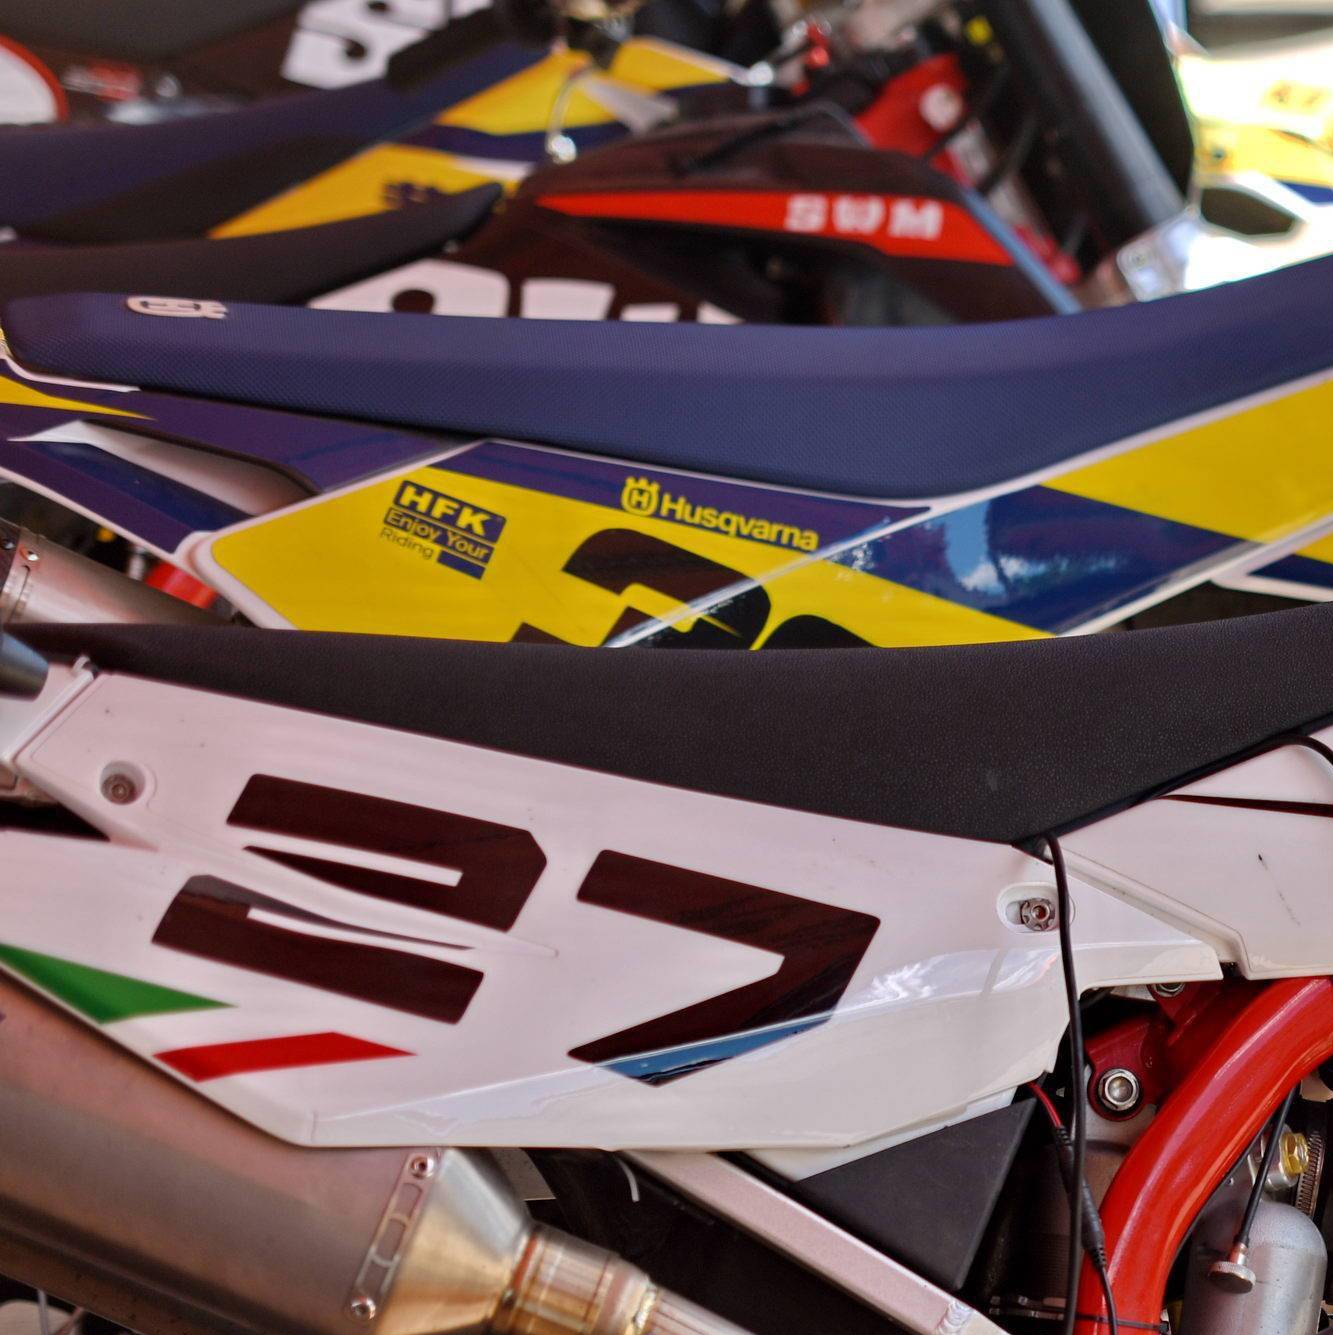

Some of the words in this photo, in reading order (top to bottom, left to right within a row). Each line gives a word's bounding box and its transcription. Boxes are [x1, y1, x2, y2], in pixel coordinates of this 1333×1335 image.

[387, 511, 441, 540] Enjoy
[447, 531, 489, 559] Your
[399, 485, 490, 536] HFK
[661, 493, 819, 551] Husqvarna
[380, 527, 434, 560] Riding
[152, 774, 881, 1087] 27
